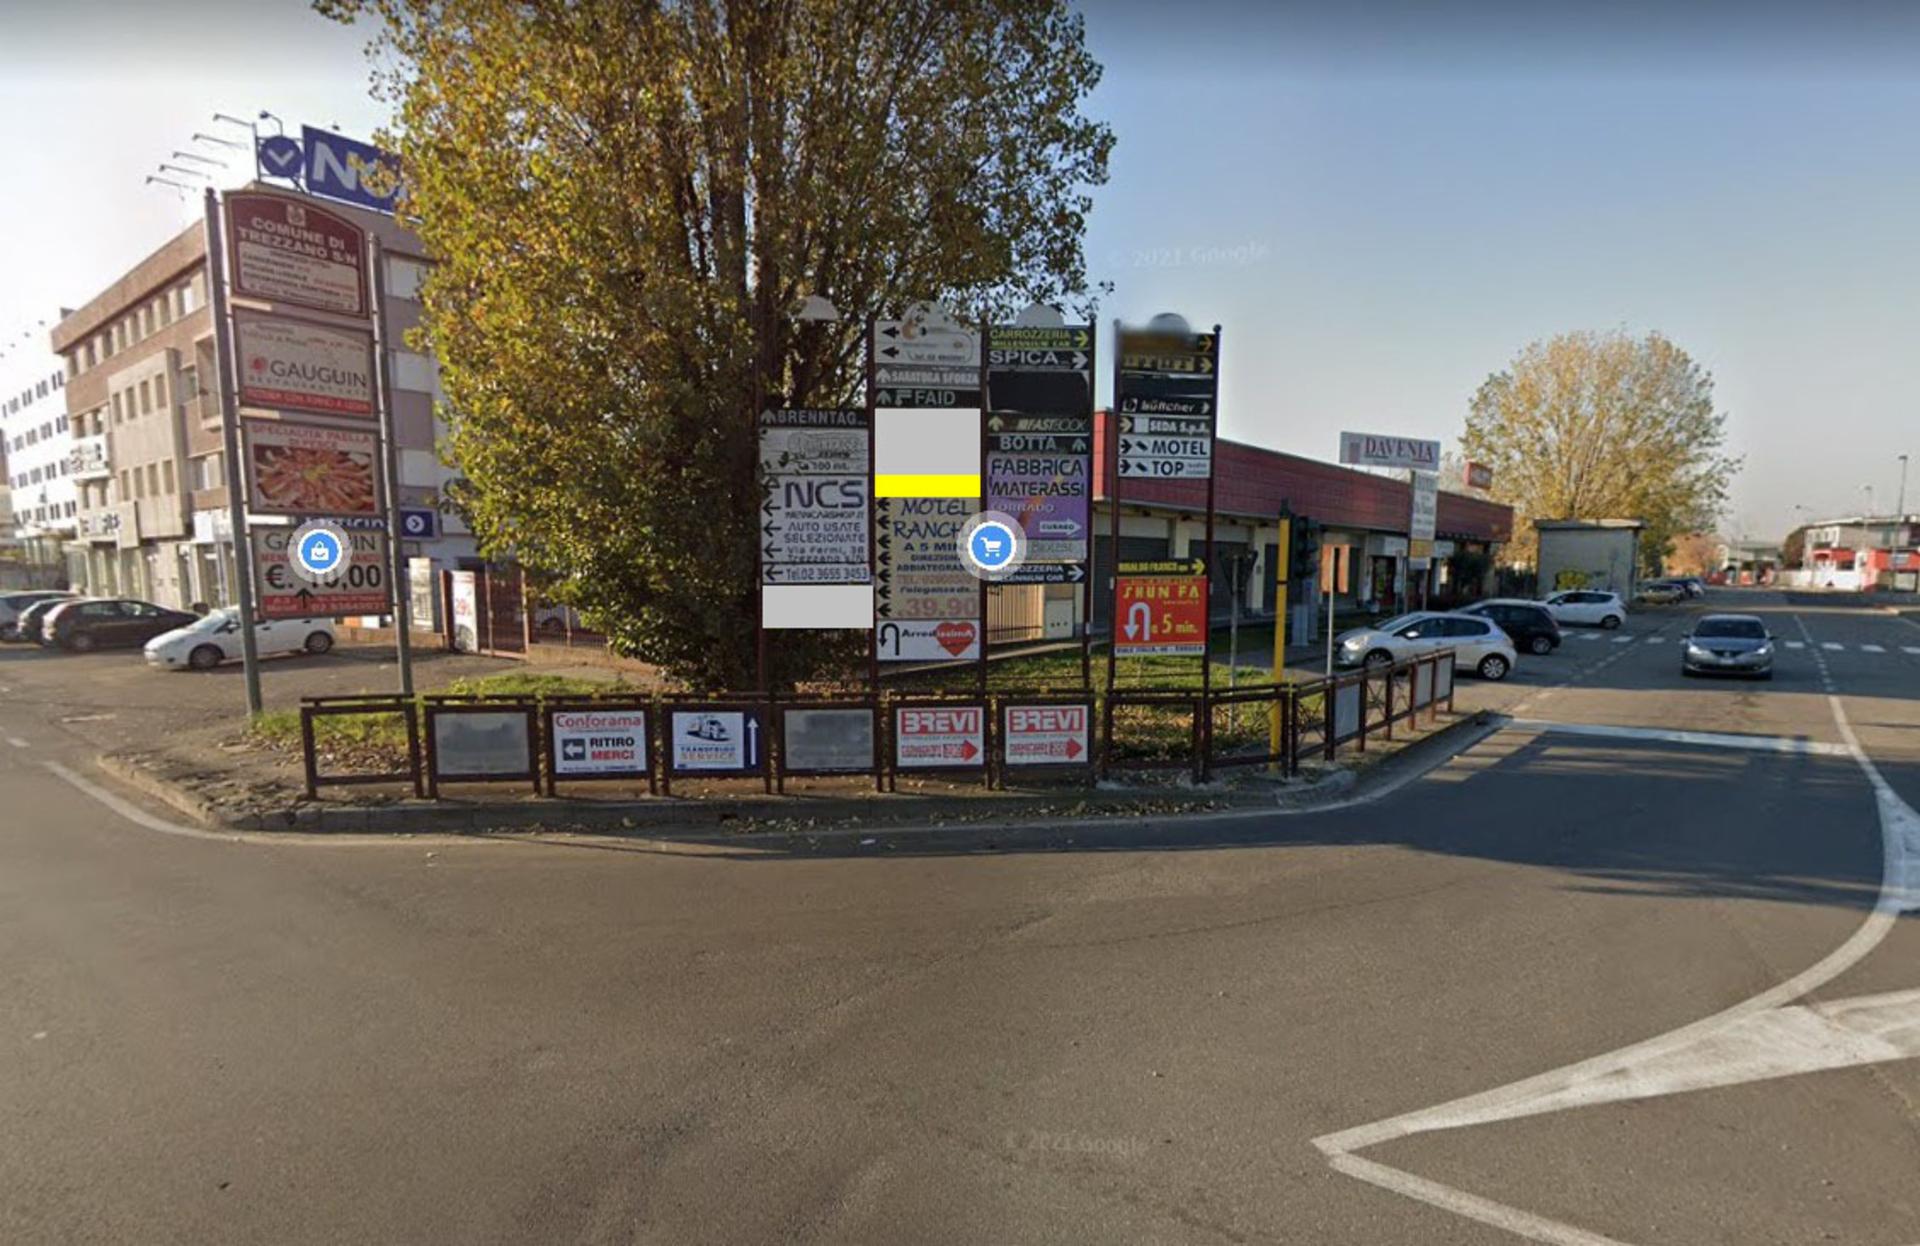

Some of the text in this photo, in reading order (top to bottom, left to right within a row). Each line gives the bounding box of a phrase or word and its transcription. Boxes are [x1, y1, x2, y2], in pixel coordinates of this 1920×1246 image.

[238, 225, 328, 258] TREZZANO
[251, 216, 346, 251] COMUNE DI
[989, 328, 1072, 340] CARROZZERIA
[989, 350, 1060, 366] SPICA
[270, 360, 367, 388] GAUGUIN
[915, 390, 957, 406] FAID
[777, 409, 857, 426] BRENNTAG
[1150, 420, 1177, 432] SEDA
[1000, 435, 1058, 451] BOTTA
[1151, 440, 1207, 455] MOTEL
[1364, 437, 1434, 463] DAVENIA
[991, 459, 1084, 477] FABBRICA
[1152, 460, 1185, 476] TOP
[785, 480, 865, 509] NCS
[991, 481, 1085, 497] MATERASSI
[901, 499, 973, 516] MOTEL
[788, 522, 861, 532] AUTO USATE
[783, 533, 866, 543] SELEZIONATE
[903, 542, 914, 552] A
[920, 543, 929, 552] 5
[1123, 585, 1200, 599] SHUN FA
[1161, 613, 1173, 634] 5
[1175, 620, 1199, 634] min.
[556, 713, 641, 728] Conforama
[905, 711, 975, 733] BREVI
[1012, 710, 1080, 731] BREVI
[590, 736, 635, 748] RITIRO
[591, 749, 635, 760] MERCI
[681, 751, 736, 760] SERVICE
